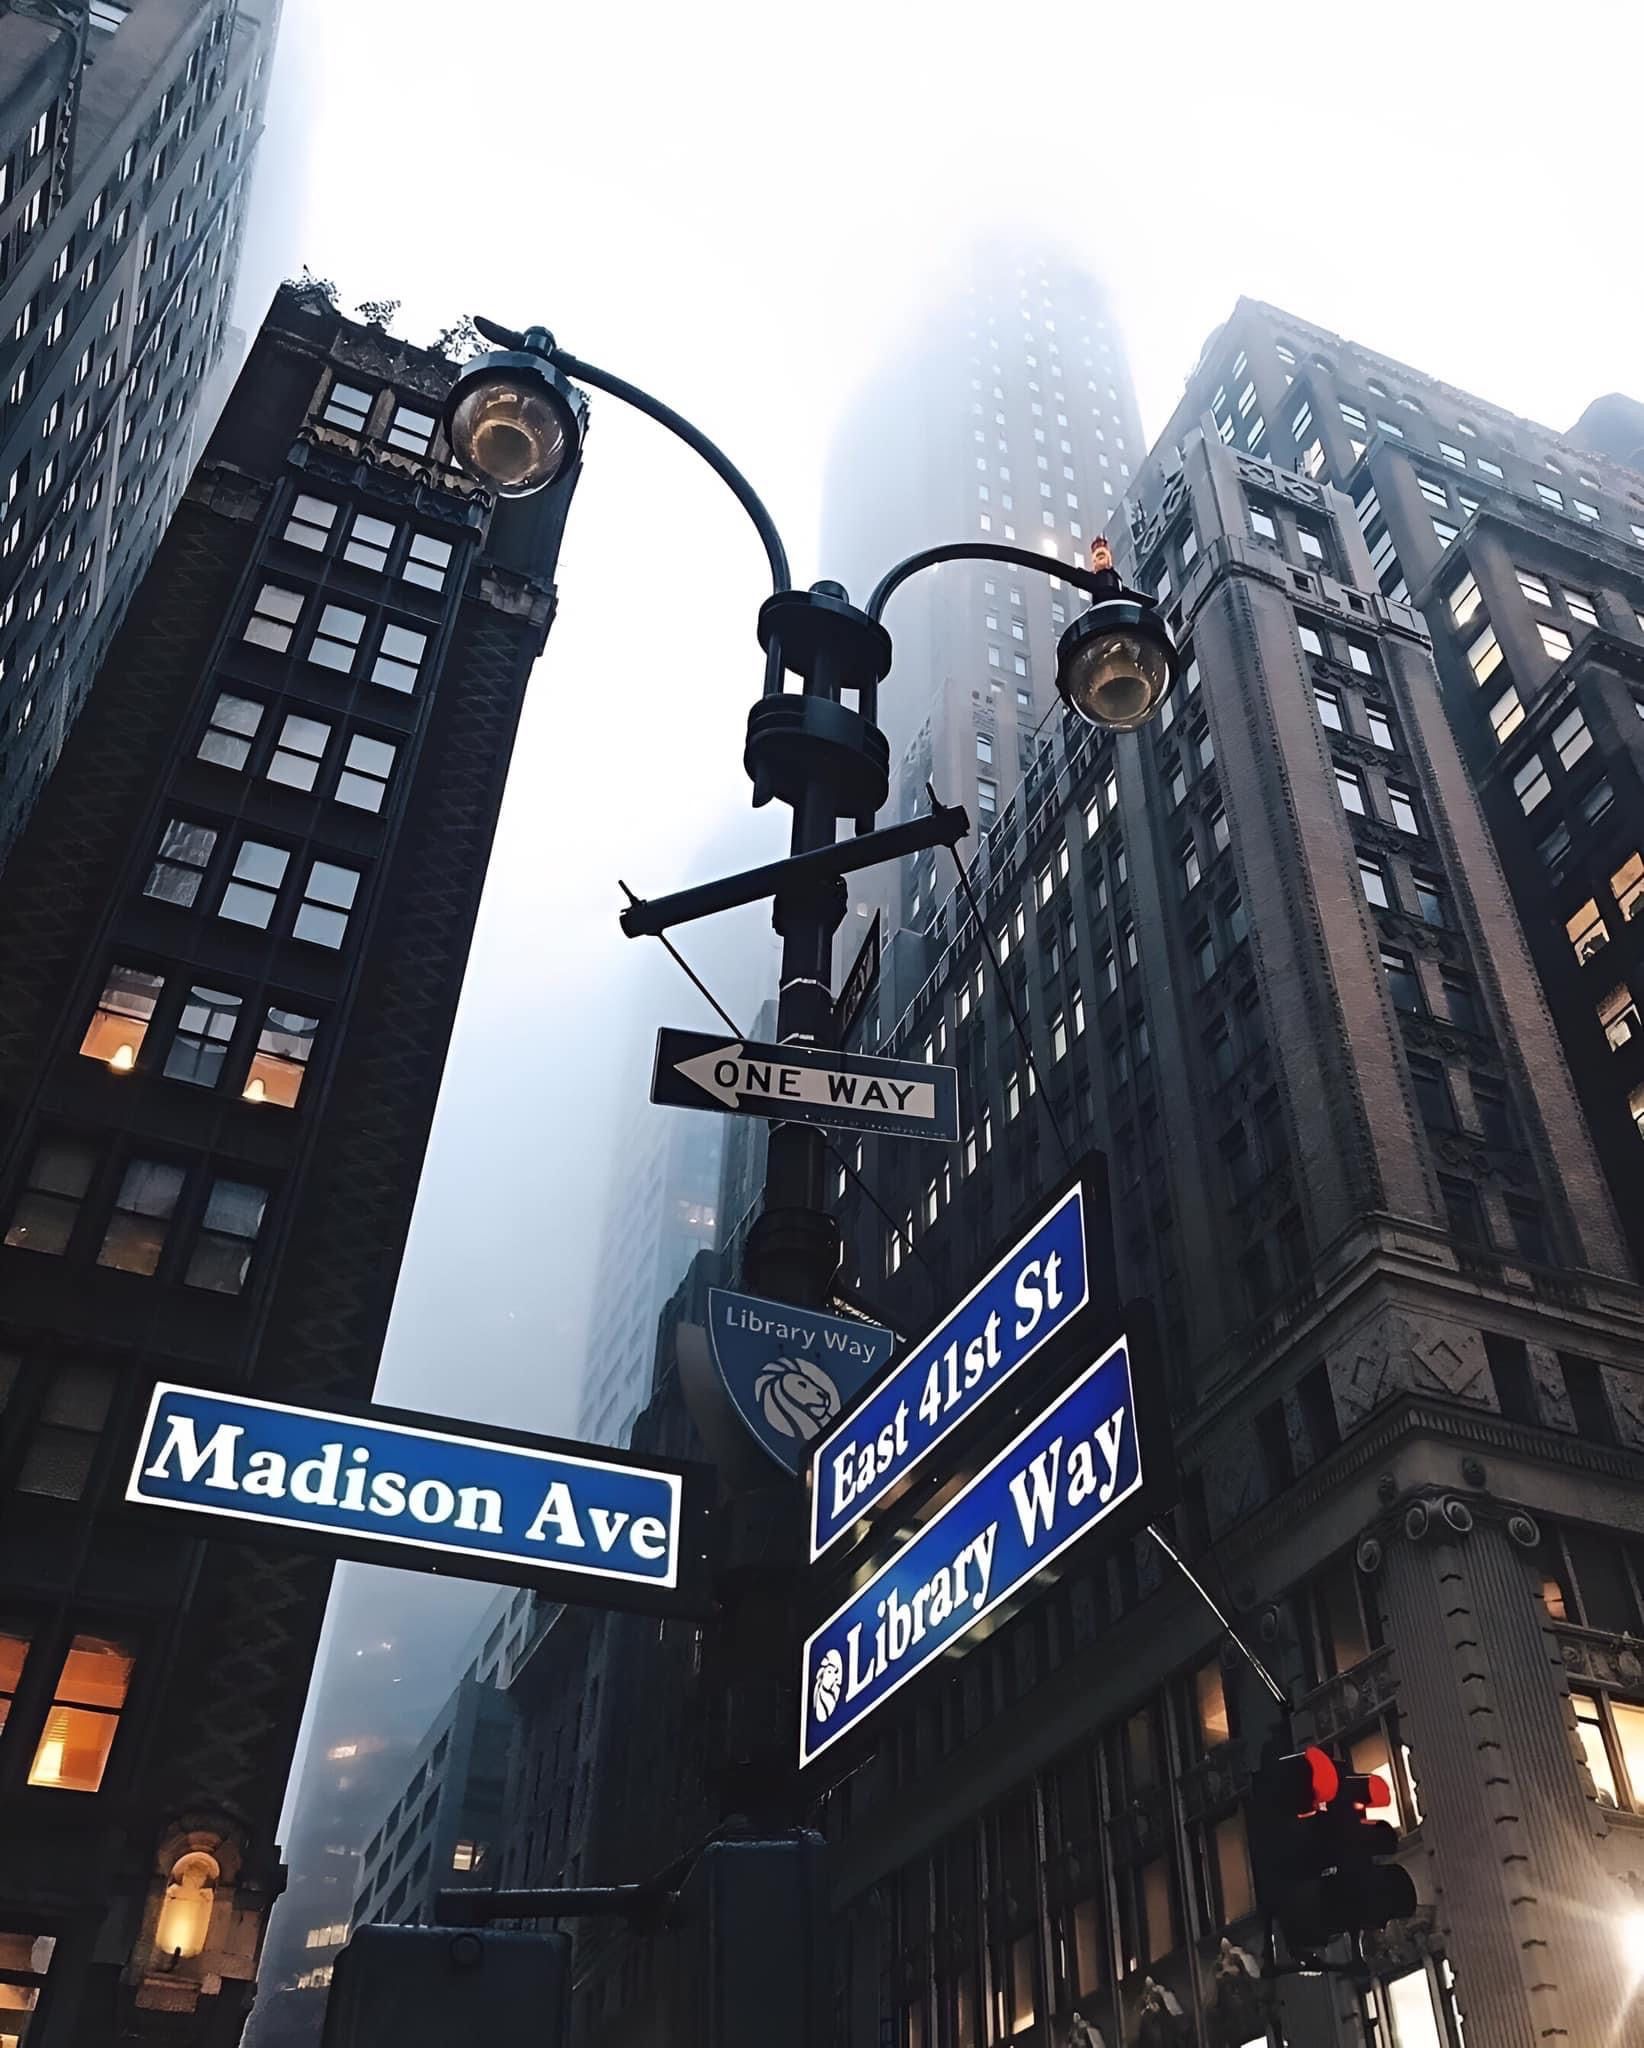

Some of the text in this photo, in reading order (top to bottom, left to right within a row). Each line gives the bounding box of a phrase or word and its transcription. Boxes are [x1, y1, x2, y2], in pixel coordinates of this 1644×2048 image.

[714, 1060, 915, 1110] ONE WAY
[727, 1306, 876, 1364] Library Way
[831, 1250, 1064, 1520] East 41st St
[145, 1415, 667, 1560] Madison Ave
[845, 1406, 1126, 1703] Library Way
